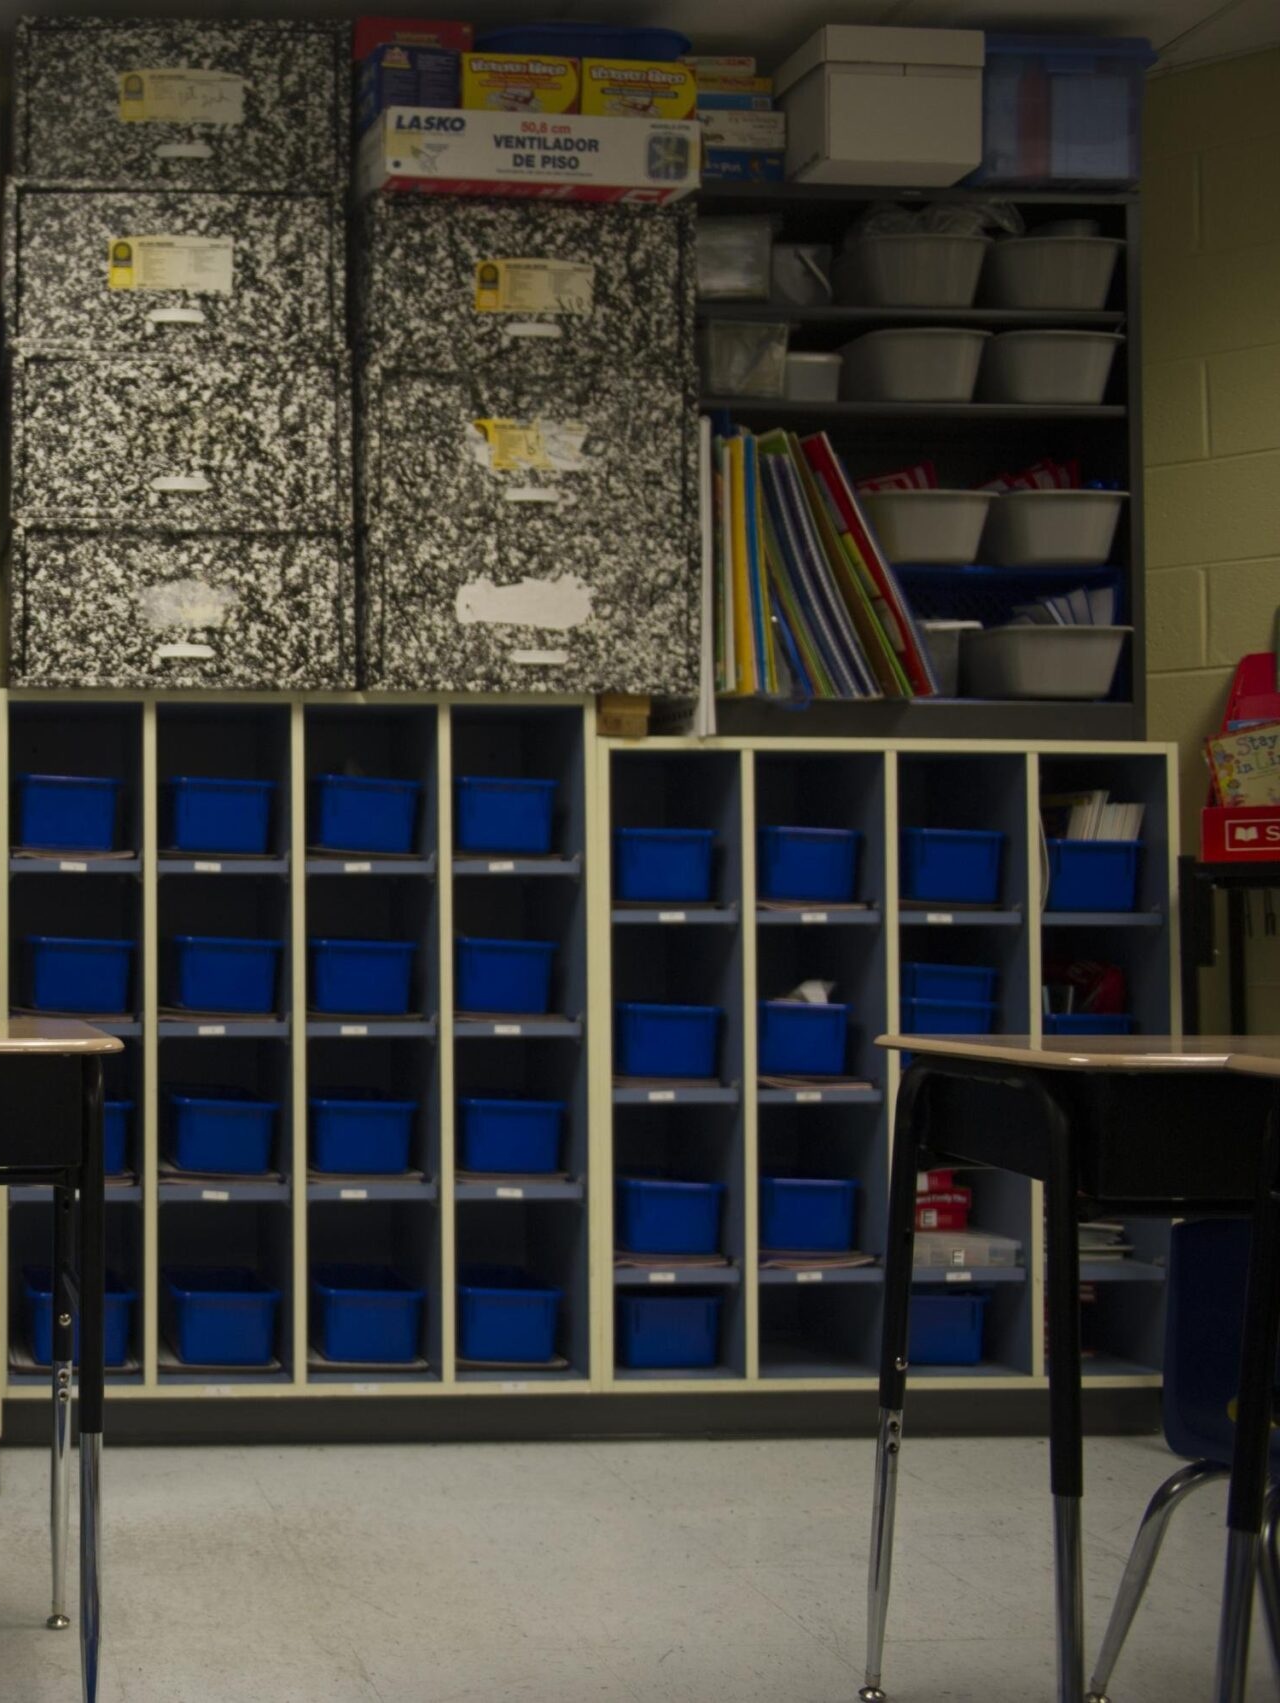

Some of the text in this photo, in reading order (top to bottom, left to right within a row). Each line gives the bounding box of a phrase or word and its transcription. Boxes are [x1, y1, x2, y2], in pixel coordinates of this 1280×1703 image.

[395, 114, 466, 133] LASKO
[551, 124, 572, 135] cm
[492, 134, 600, 153] VENTILADOR
[512, 153, 580, 170] DE PISO
[1236, 735, 1278, 756] Stay
[1235, 758, 1254, 775] in
